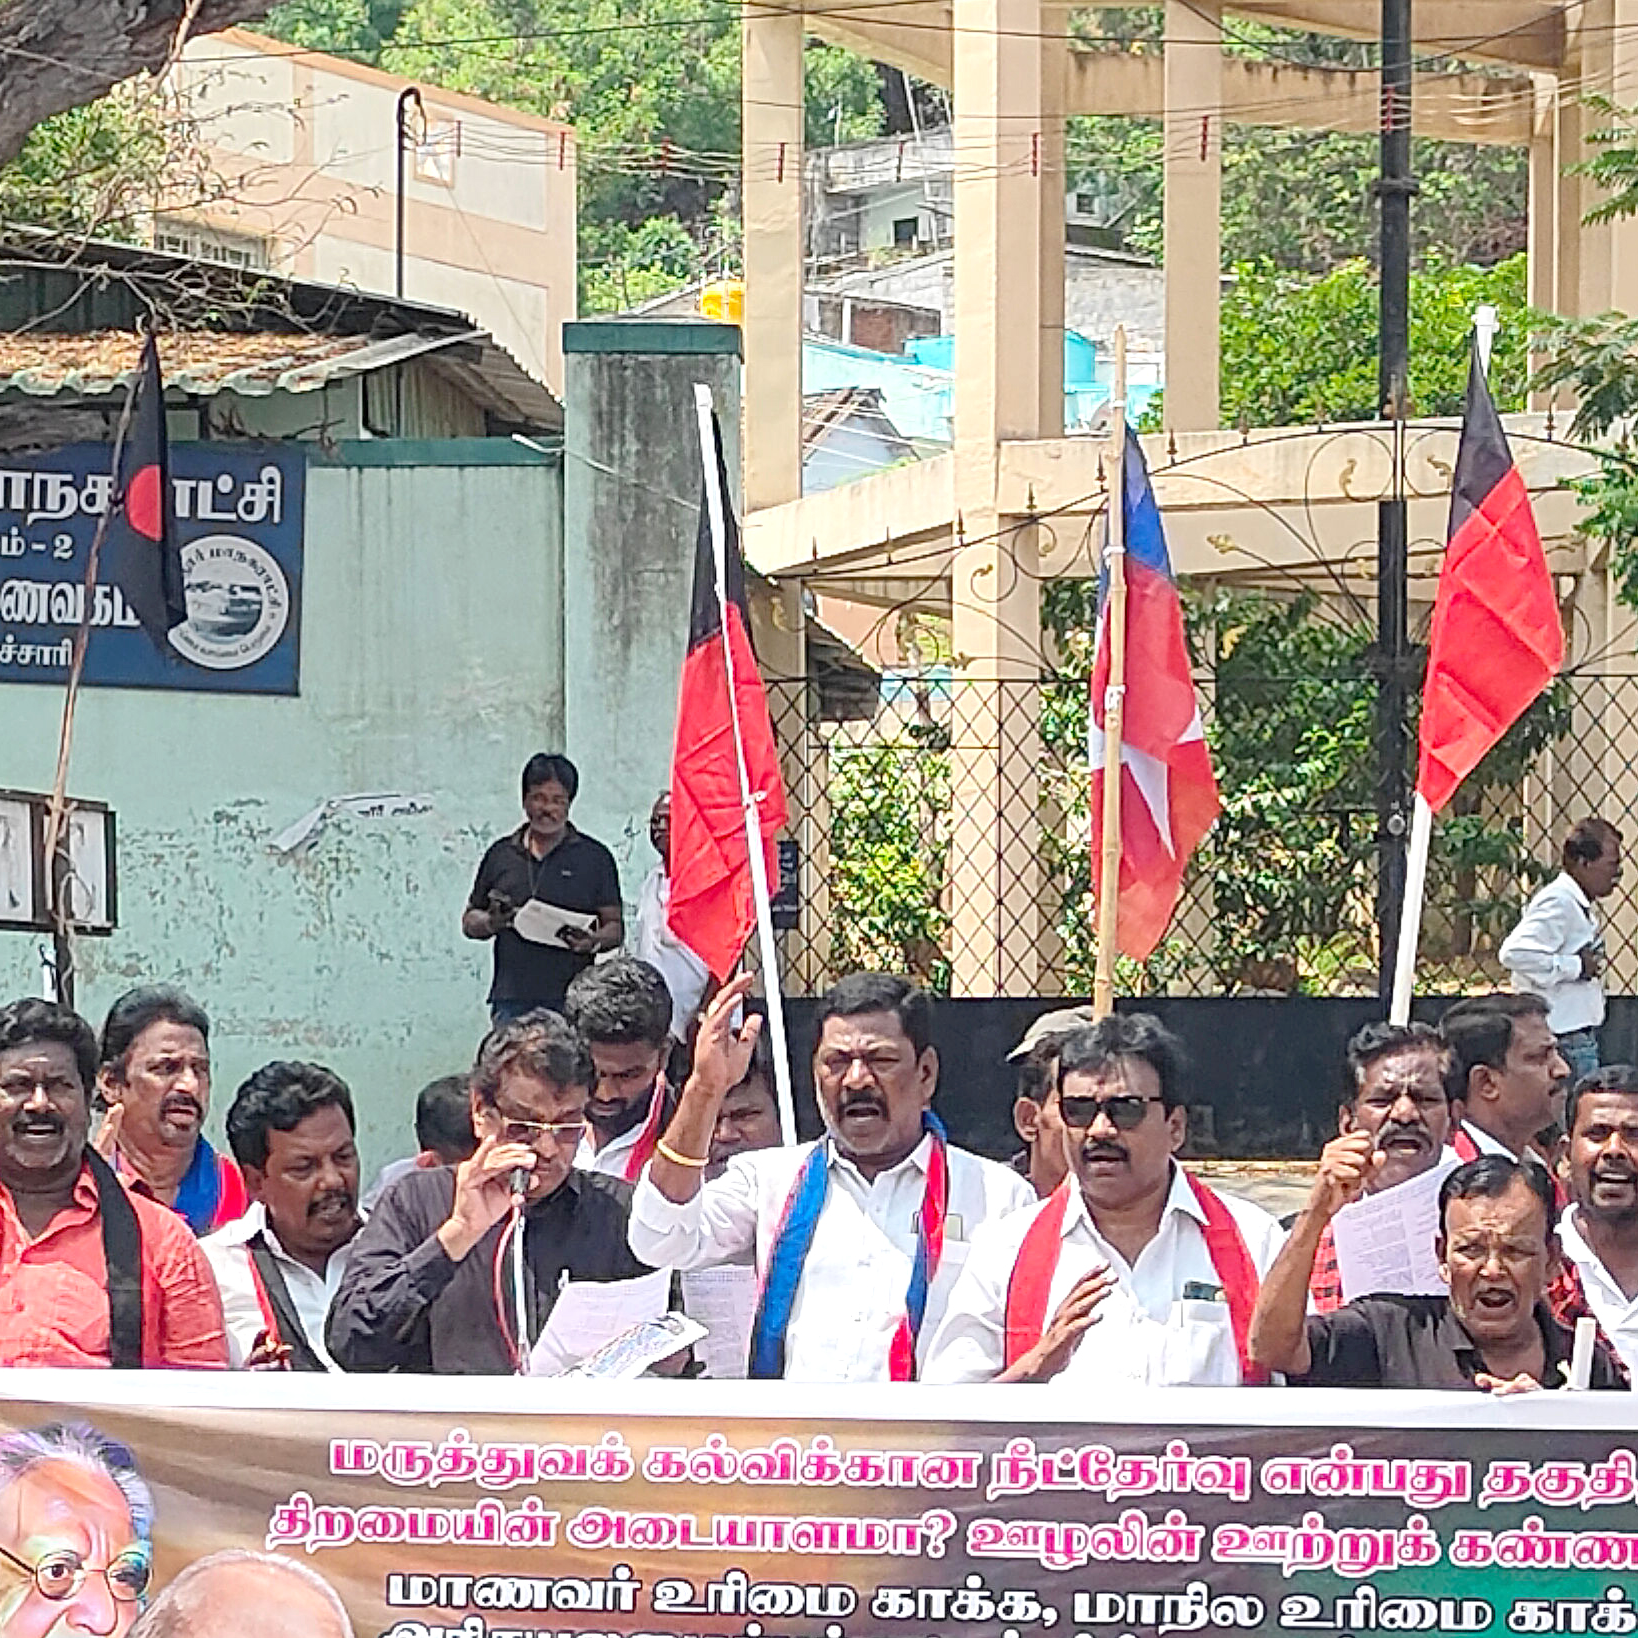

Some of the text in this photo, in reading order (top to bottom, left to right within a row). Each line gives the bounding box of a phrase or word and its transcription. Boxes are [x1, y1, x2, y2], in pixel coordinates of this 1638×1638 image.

[53, 533, 74, 559] 2
[330, 1427, 633, 1487] மருத்துவக்
[642, 1435, 983, 1490] கல்விக்கான
[988, 1437, 1251, 1500] நீட்தேர்வு
[1261, 1441, 1471, 1506] என்பது
[265, 1491, 561, 1551] திறமையின்
[566, 1507, 956, 1557] அடையாளமா?
[966, 1510, 1204, 1570] ஊழலின்
[1212, 1512, 1441, 1576] ஊற்றுக்
[386, 1564, 641, 1615] மாணவர்
[652, 1569, 858, 1620] உரிமை
[870, 1574, 1057, 1628] காக்க,
[1073, 1581, 1265, 1632] மாநில
[1279, 1584, 1493, 1634] உரிமை
